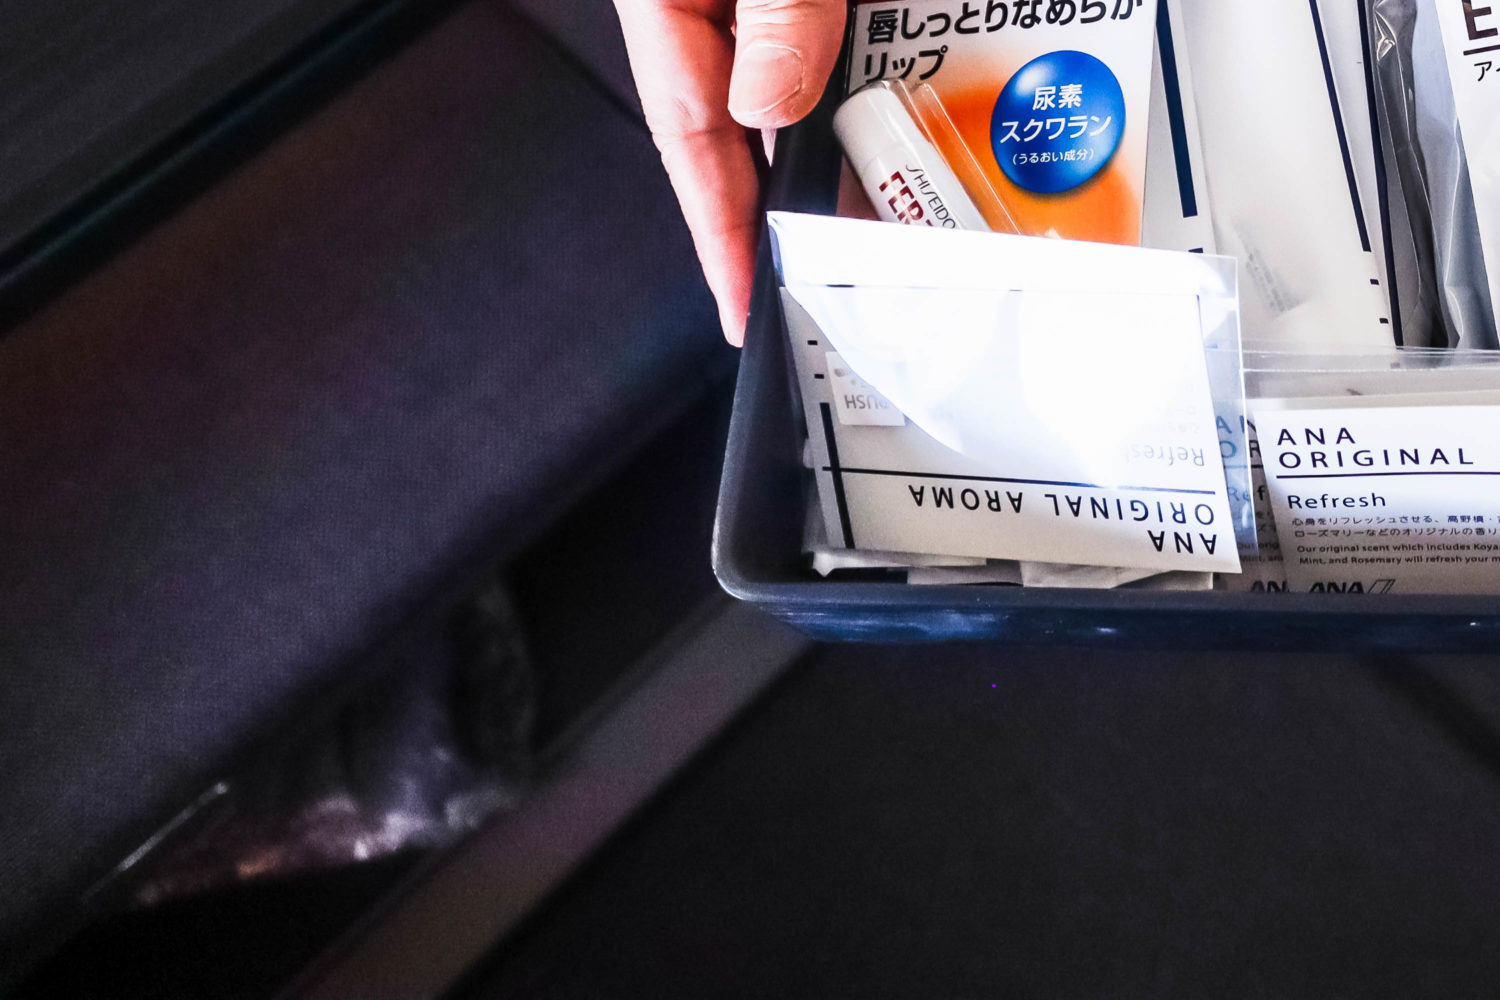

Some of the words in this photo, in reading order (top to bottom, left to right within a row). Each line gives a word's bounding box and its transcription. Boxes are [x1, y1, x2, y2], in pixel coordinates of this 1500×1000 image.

[863, 45, 949, 83] リップ
[1032, 84, 1083, 110] 尿素
[1000, 114, 1112, 143] スクワラン
[906, 163, 957, 230] SHISEIDO
[1277, 428, 1356, 446] ANA
[1278, 448, 1475, 468] ORIGINAL
[909, 484, 1023, 514] AROMA
[1045, 493, 1215, 526] ORIGINAL
[1287, 493, 1387, 509] Refresh
[1148, 530, 1217, 555] ANA
[1297, 545, 1316, 553] Our
[1319, 544, 1360, 554] original
[1362, 544, 1390, 552] scent
[1392, 543, 1424, 551] which
[1426, 543, 1471, 551] includes
[1328, 556, 1349, 565] and
[1351, 556, 1402, 566] Rosemary
[1404, 555, 1423, 564] will
[1425, 555, 1463, 564] refresh
[1465, 556, 1488, 565] your
[1308, 579, 1365, 594] ANA
